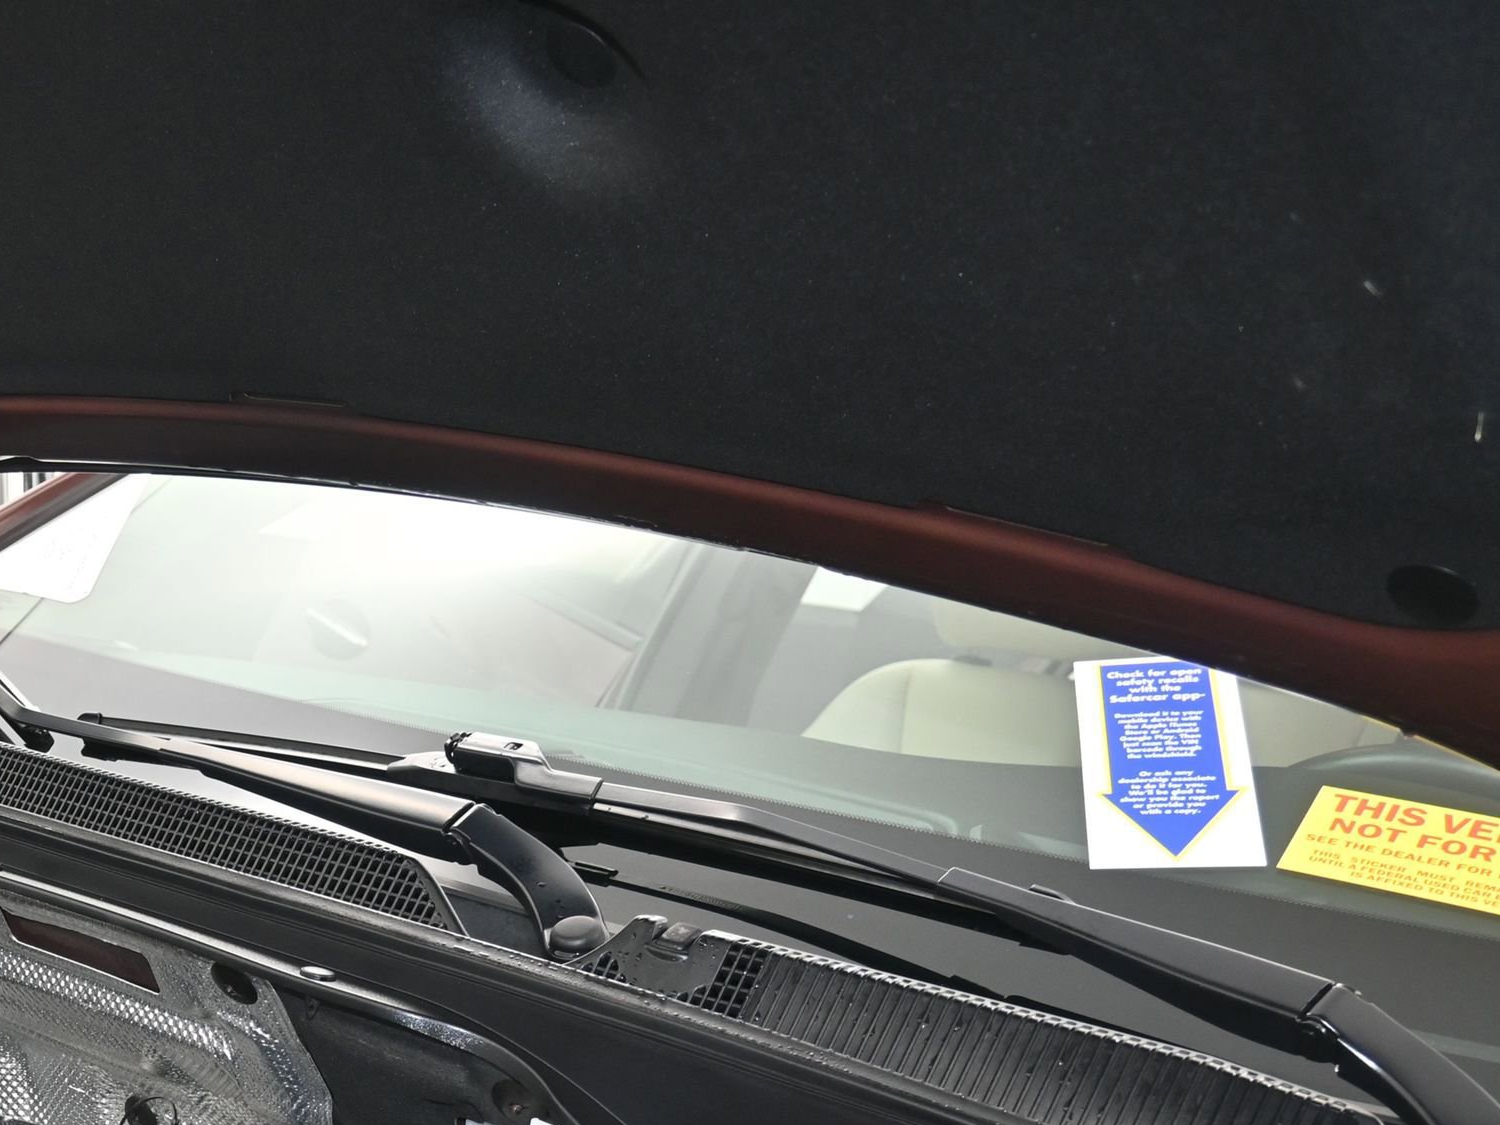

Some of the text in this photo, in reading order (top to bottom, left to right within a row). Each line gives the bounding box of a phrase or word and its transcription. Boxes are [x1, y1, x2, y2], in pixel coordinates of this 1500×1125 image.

[1107, 668, 1201, 679] Check for open
[1116, 675, 1199, 688] safety recalls
[1334, 794, 1500, 843] THIS VE
[1305, 834, 1493, 876] SEE THE DEALER FOR
[1329, 818, 1497, 862] NOT FOR
[1309, 856, 1345, 867] UNTIL
[1359, 867, 1418, 883] FEDERAL
[1424, 879, 1460, 891] USED
[1463, 885, 1493, 898] CAR
[1313, 850, 1341, 860] THIS
[1351, 856, 1407, 873] STICKER
[1416, 870, 1456, 882] MUST
[1367, 873, 1423, 891] AFFIXED
[1427, 885, 1443, 895] TO
[1449, 888, 1478, 903] THIS
